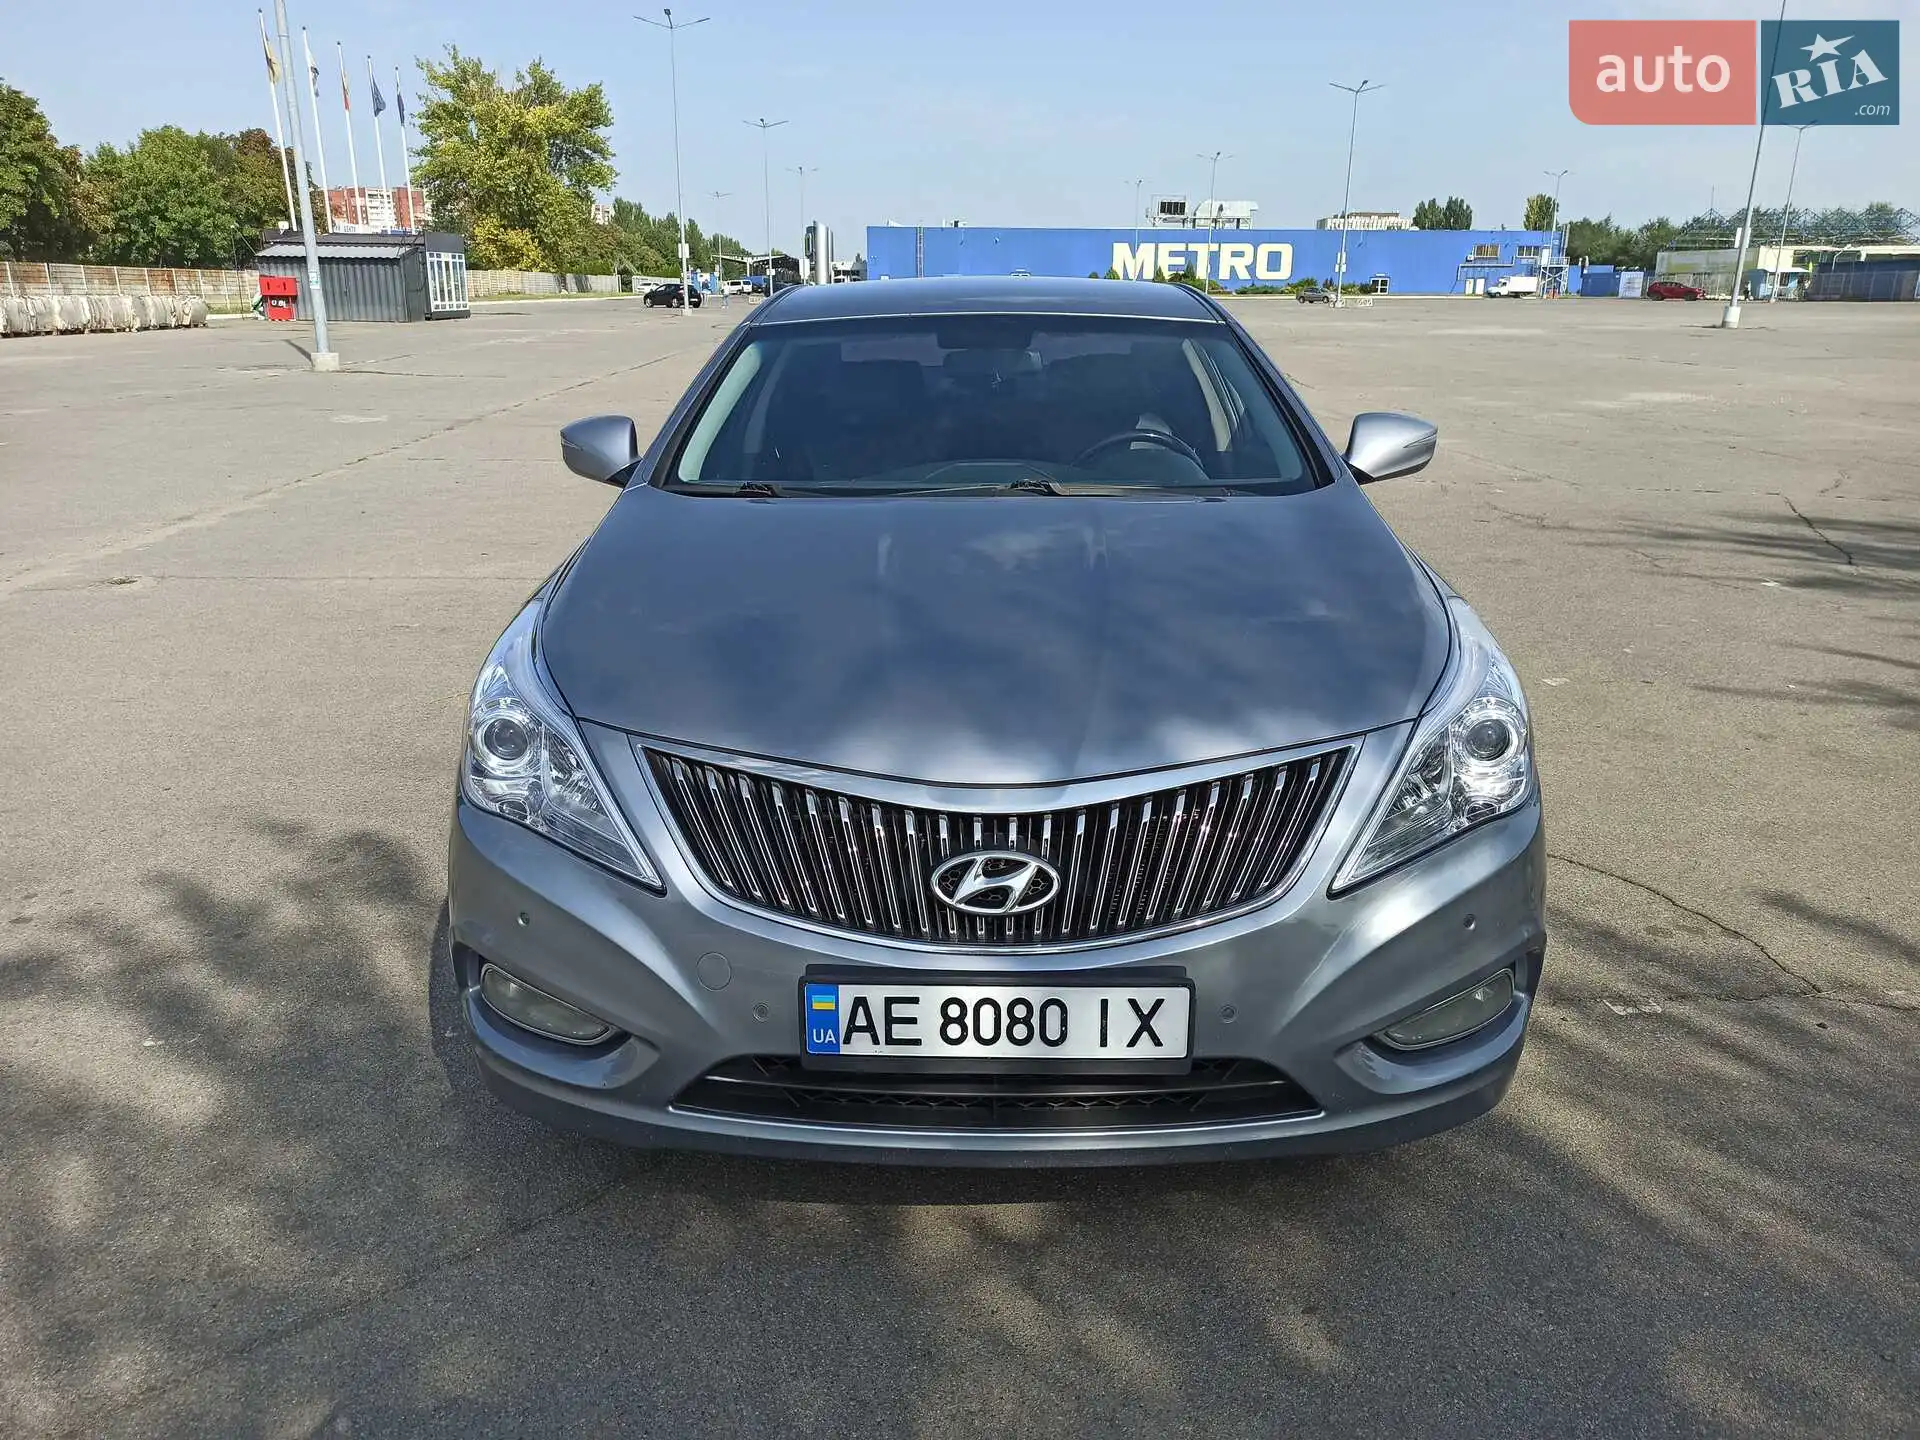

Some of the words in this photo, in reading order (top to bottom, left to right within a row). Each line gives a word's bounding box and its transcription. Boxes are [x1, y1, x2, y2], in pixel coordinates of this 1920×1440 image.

[1112, 242, 1294, 281] METRO
[812, 1028, 837, 1044] UA
[842, 996, 922, 1046] AE
[939, 997, 1068, 1047] 8080
